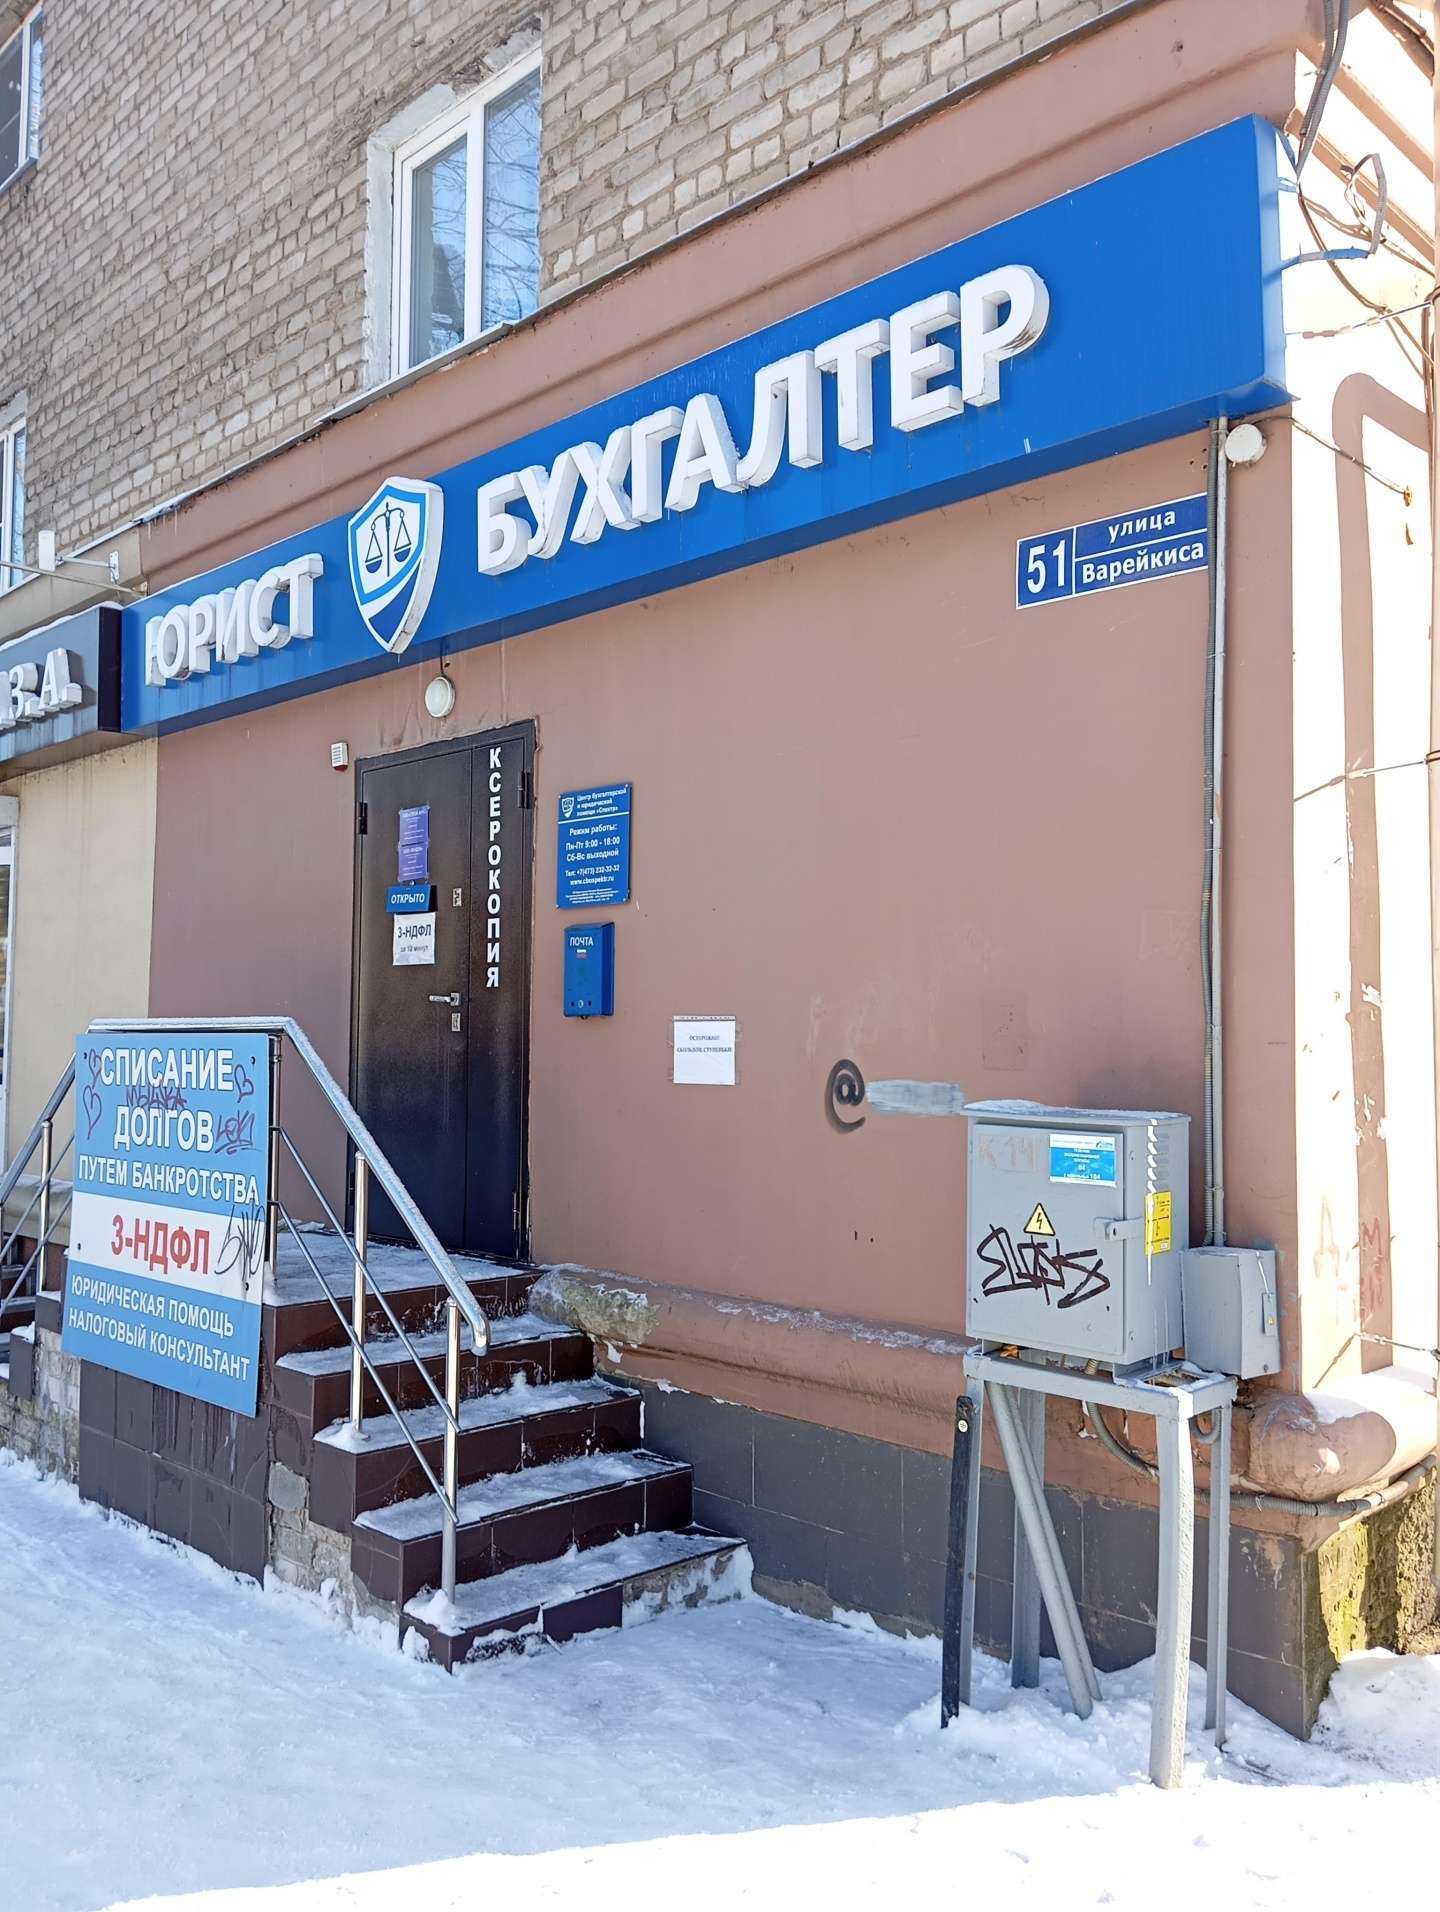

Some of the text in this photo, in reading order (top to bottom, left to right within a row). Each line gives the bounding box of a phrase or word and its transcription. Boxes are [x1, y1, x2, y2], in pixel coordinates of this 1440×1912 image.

[477, 264, 1050, 576] БУХГАЛТЕР
[1108, 510, 1176, 544] улица
[1027, 539, 1066, 594] 51
[1082, 541, 1205, 584] Варейкиса
[145, 552, 324, 687] ЮРИСТ
[566, 842, 584, 851] Пн-Пт
[585, 839, 598, 849] 9:00
[604, 836, 620, 846] 18:00
[569, 823, 618, 836] Режим работы:
[485, 747, 502, 988] КСЕРОКОПИЯ
[567, 847, 619, 862] Сб-Вс выходной
[391, 893, 425, 904] ОТКРЫТО
[397, 924, 432, 940] 3-НДФЛ
[569, 936, 594, 947] ПОЧТА
[100, 1048, 234, 1092] СПИСАНИЕ
[113, 1105, 214, 1152] ДОЛГОВ
[78, 1154, 260, 1206] ПУТЕМ БАНКРОТСТВА
[111, 1215, 210, 1275] 3-НДФЛ
[71, 1275, 234, 1339] ЮРИДИЧЕСКАЯ ПОМОЩЬ
[68, 1308, 251, 1382] НАЛОГОВЫЙ КОНСУЛЬТАНТ
